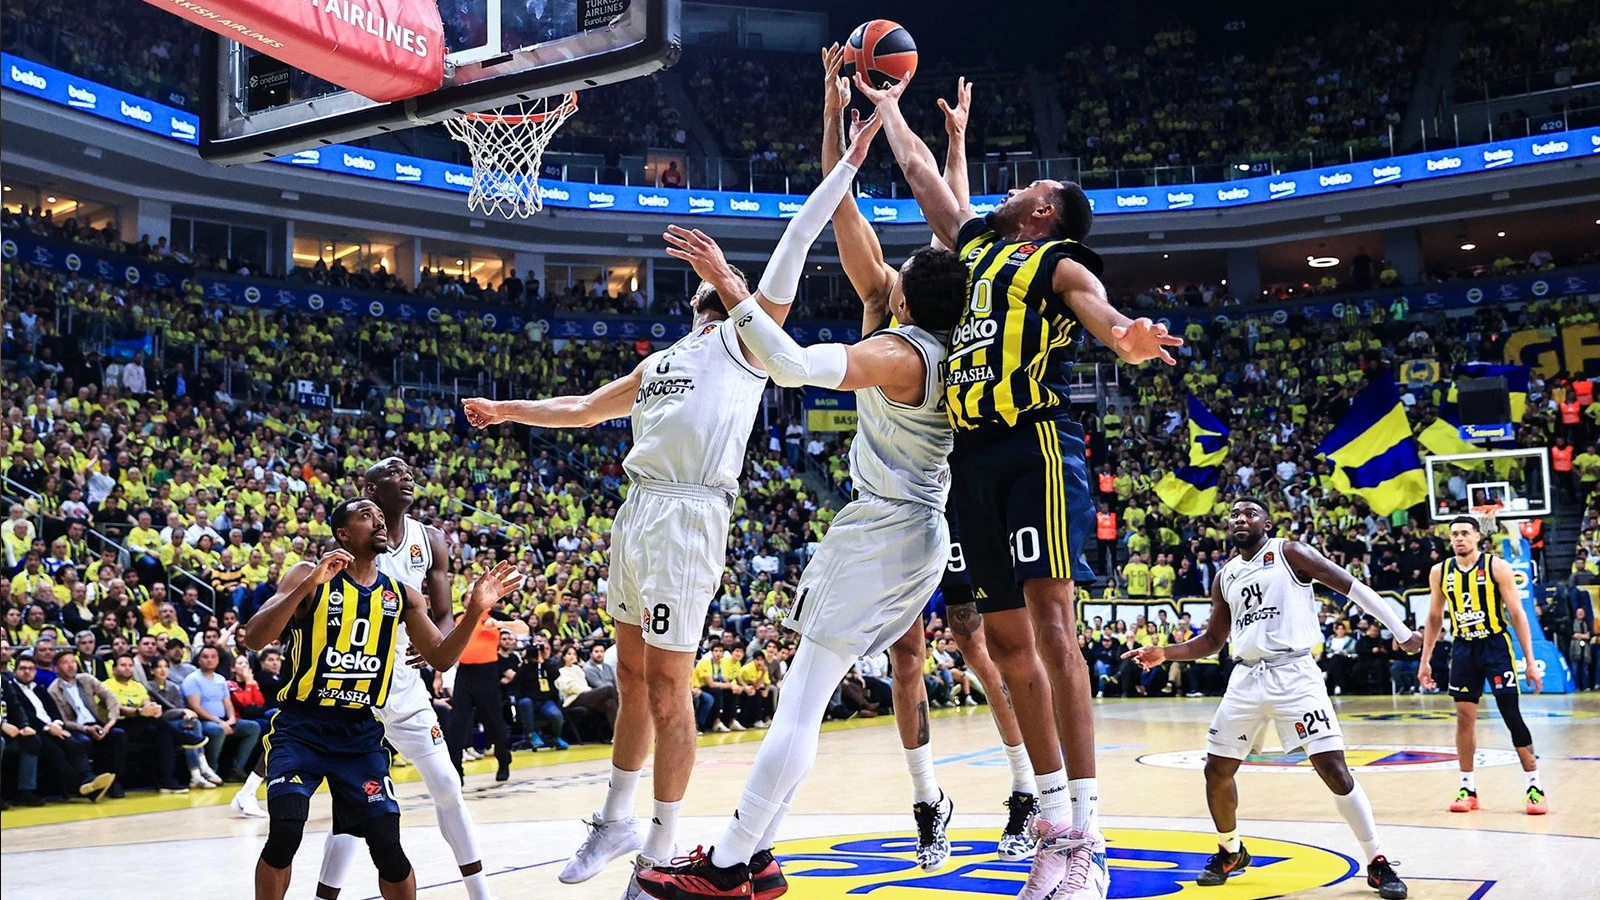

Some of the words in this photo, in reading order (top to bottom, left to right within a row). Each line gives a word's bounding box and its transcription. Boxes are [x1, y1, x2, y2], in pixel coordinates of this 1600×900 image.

[585, 2, 624, 18] AIRLINES
[586, 0, 621, 8] TURKIS
[217, 19, 284, 48] AIRLINES
[325, 0, 428, 58] AIRLINES
[12, 65, 47, 90] beko
[260, 72, 289, 85] oneteam
[68, 84, 96, 103] beko
[121, 100, 152, 123] beko
[171, 117, 196, 135] beko
[1541, 120, 1563, 131] 420
[1483, 149, 1514, 162] beko
[1532, 141, 1569, 156] beko
[343, 153, 376, 171] beko
[395, 162, 422, 177] beko
[1426, 157, 1461, 171] beko
[1319, 172, 1353, 187] beko
[1373, 166, 1401, 178] beko
[1269, 181, 1296, 192] beko
[588, 191, 615, 203] beko
[638, 194, 669, 207] beko
[689, 196, 715, 208] beko
[1117, 195, 1148, 207] beko
[1167, 192, 1194, 203] beko
[1217, 188, 1249, 201] beko
[730, 198, 760, 212] beko
[873, 205, 898, 216] beko
[952, 317, 998, 346] beko
[953, 366, 995, 384] PASHA
[1241, 583, 1262, 610] 24
[1461, 592, 1472, 608] 2
[651, 603, 670, 635] 8
[1455, 610, 1486, 622] beko
[350, 618, 370, 646] 0
[326, 646, 381, 672] beko
[1503, 671, 1516, 687] 2
[329, 689, 371, 704] PASHA
[1303, 709, 1331, 735] 24
